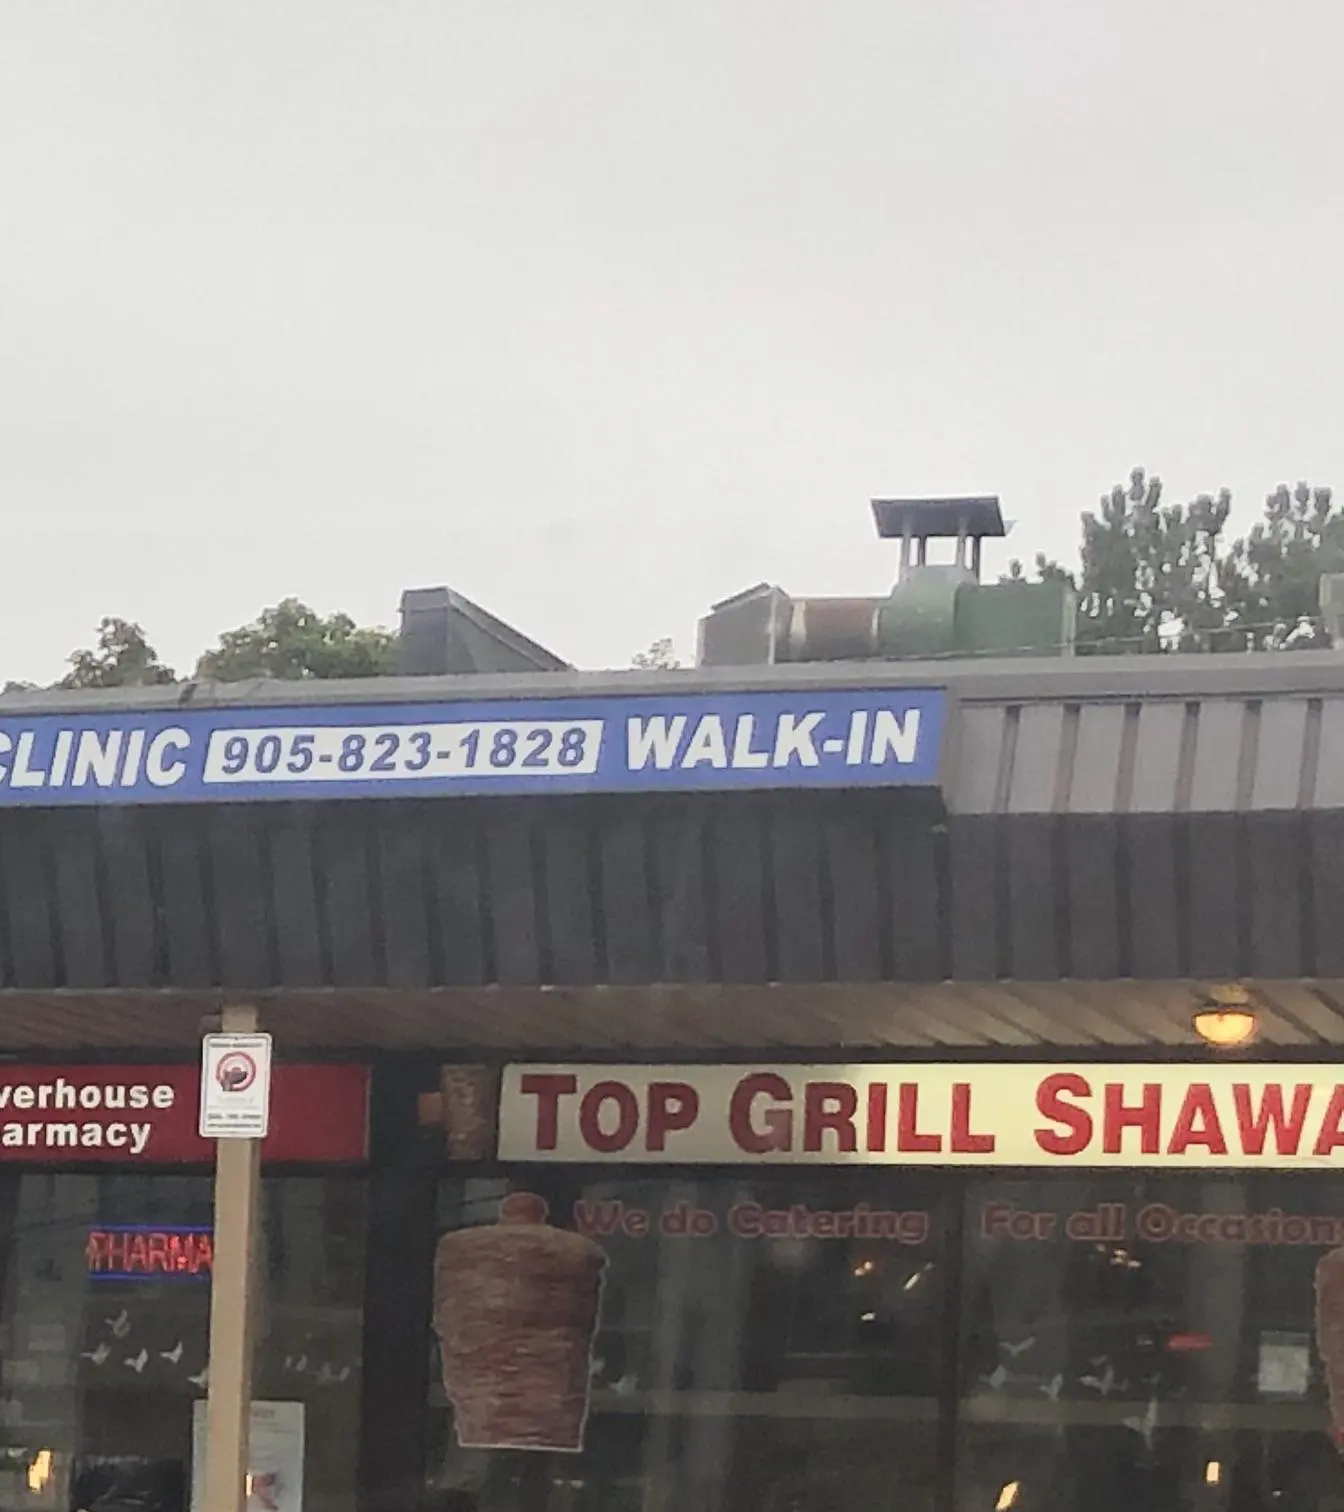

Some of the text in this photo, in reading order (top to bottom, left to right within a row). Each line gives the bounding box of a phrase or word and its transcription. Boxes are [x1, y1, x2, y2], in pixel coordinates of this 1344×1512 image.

[222, 726, 588, 775] 905-823-1828
[626, 708, 922, 771] WALK-IN
[520, 1073, 699, 1153] TOP
[728, 1072, 996, 1154] GRILL
[573, 1199, 930, 1245] We do Catering
[981, 1202, 1057, 1240] For
[1065, 1202, 1127, 1241] all
[88, 1231, 213, 1274] PHARMA
